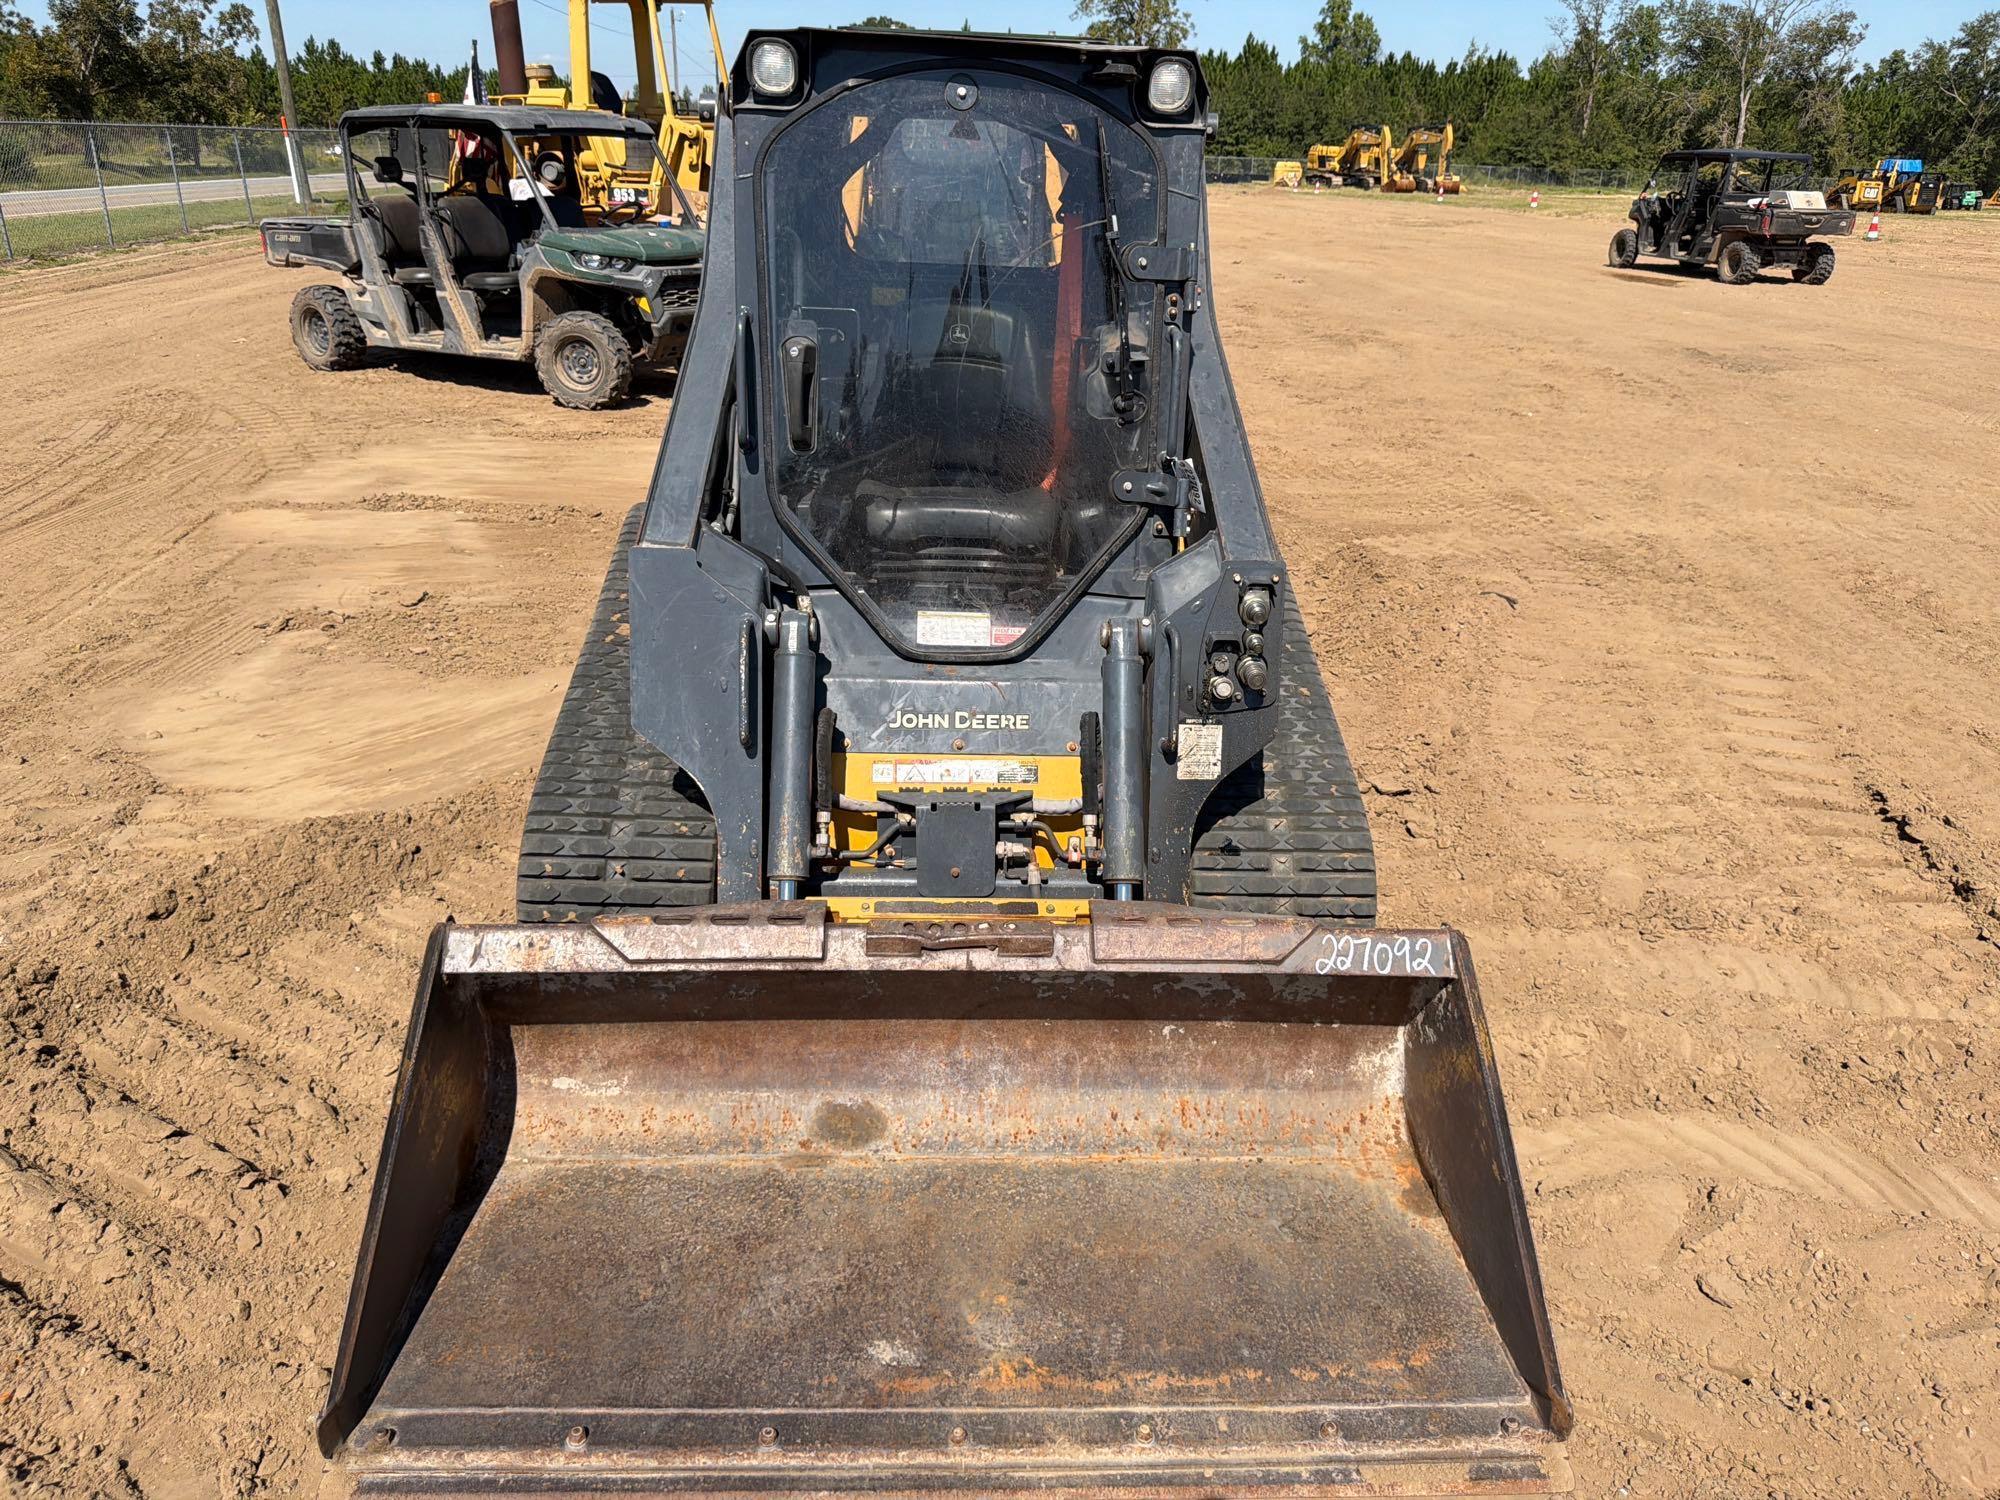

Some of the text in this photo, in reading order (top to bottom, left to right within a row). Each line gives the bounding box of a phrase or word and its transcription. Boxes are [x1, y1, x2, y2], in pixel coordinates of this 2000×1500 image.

[613, 187, 636, 203] 953
[1864, 187, 1879, 198] CAT
[889, 710, 1030, 729] JOHN DEERE
[1315, 933, 1437, 975] 227092
